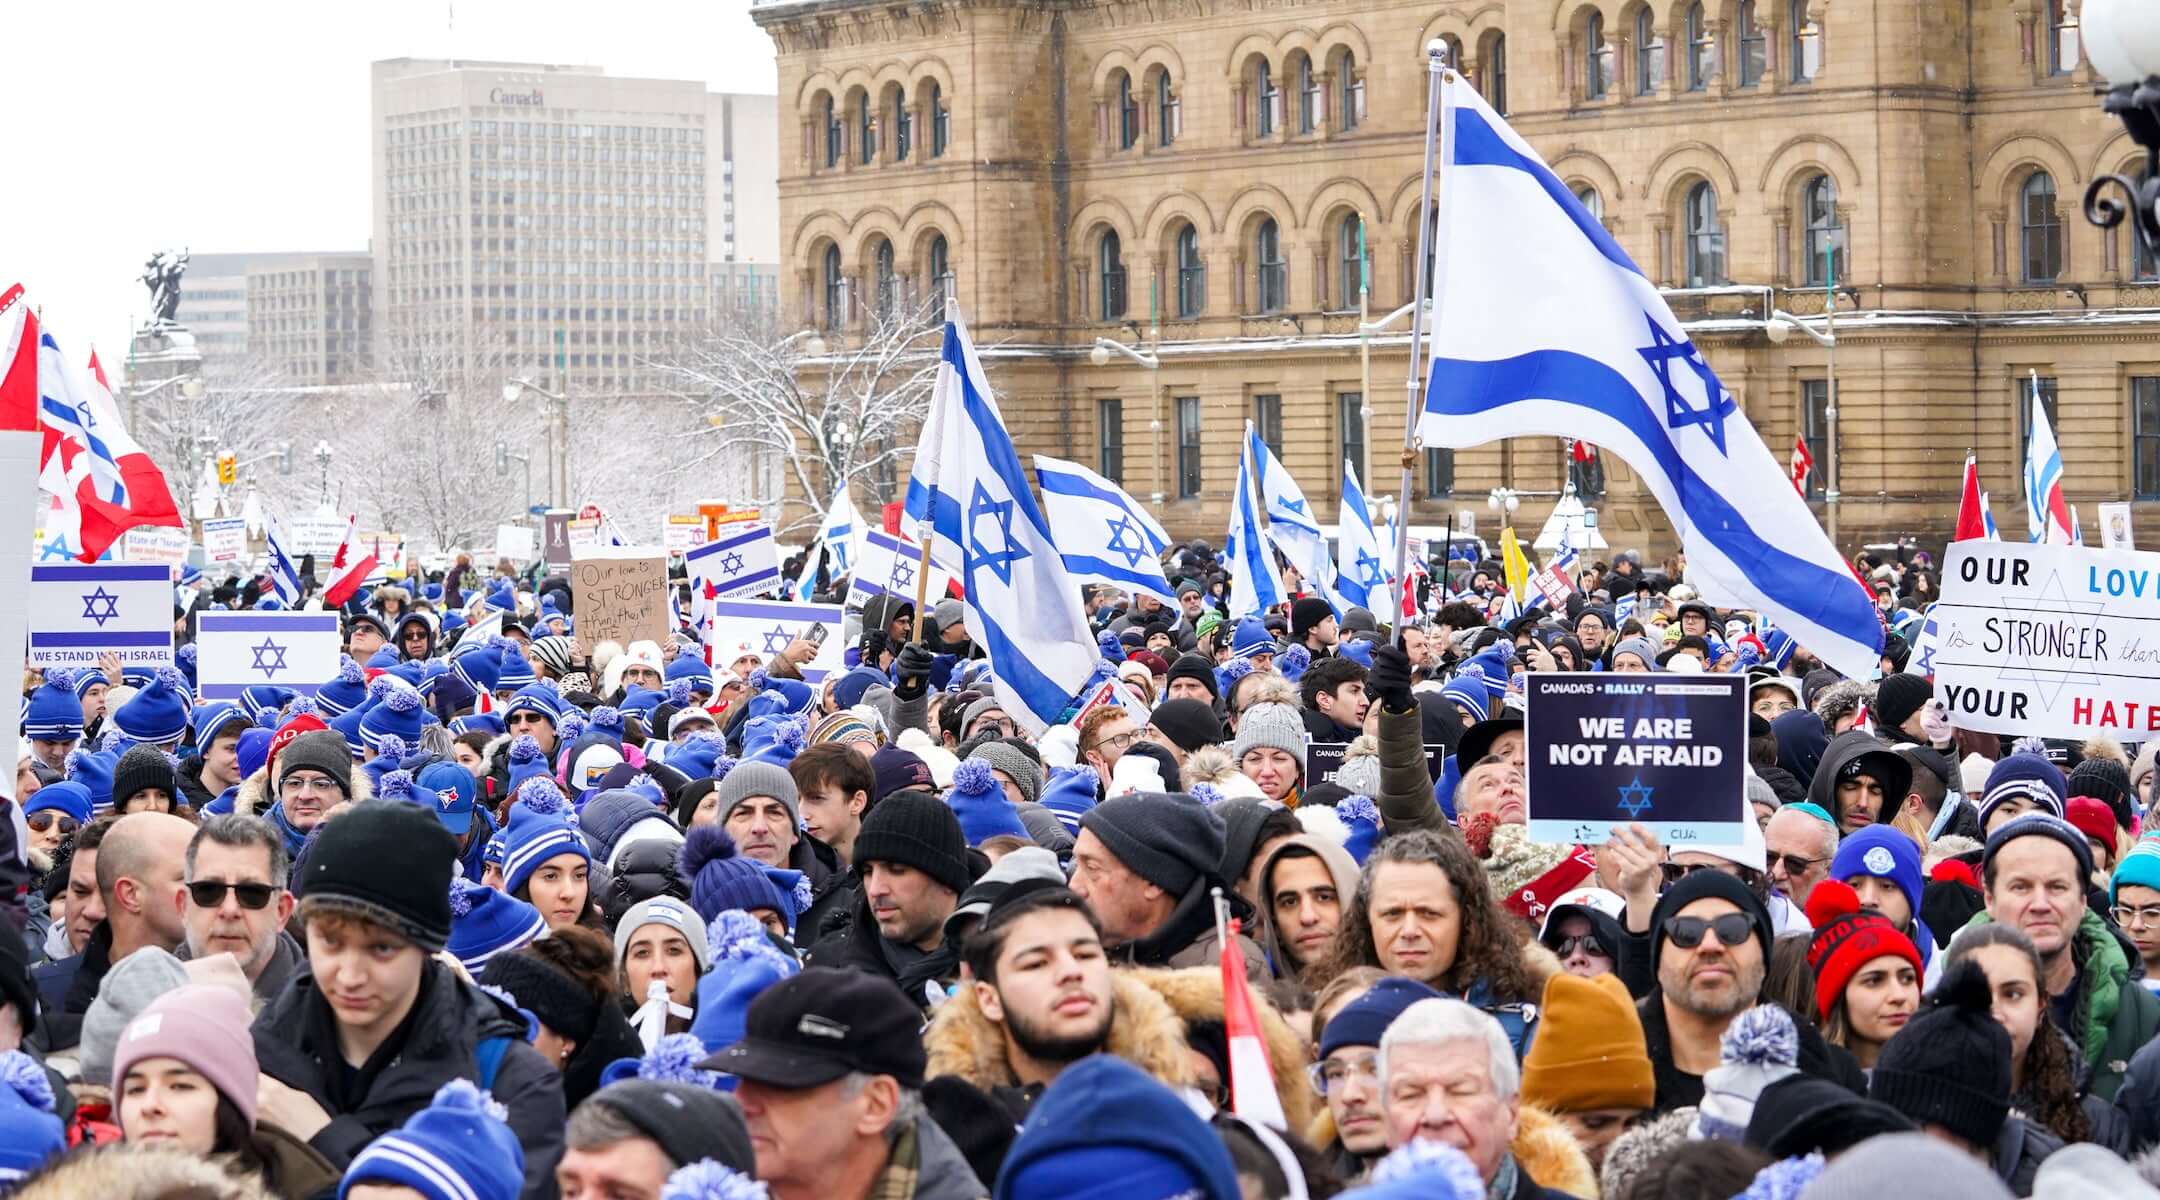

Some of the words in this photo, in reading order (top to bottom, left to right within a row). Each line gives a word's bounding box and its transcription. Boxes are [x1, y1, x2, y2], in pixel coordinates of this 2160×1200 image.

[489, 86, 544, 105] Canada
[581, 564, 613, 586] Our
[639, 561, 649, 573] is
[1961, 556, 2030, 586] OUR
[2089, 565, 2160, 600] LOV
[587, 576, 666, 612] STRONGER
[735, 585, 755, 598] WITH
[756, 577, 780, 591] ISRAEL
[852, 590, 864, 602] WE
[583, 626, 622, 643] HATE
[1945, 621, 1974, 649] is
[1983, 616, 2108, 662] STRONGER
[2118, 637, 2160, 664] than
[34, 651, 51, 661] WE
[54, 650, 94, 662] STAND
[97, 650, 127, 661] WH
[130, 650, 171, 661] ISRAEL
[1540, 683, 1595, 695] CANADA'S
[1604, 683, 1646, 695] RALLY
[1944, 684, 2029, 720] YOUR
[2072, 697, 2160, 731] HATE
[1579, 717, 1625, 739] WE
[1632, 717, 1693, 740] ARE
[1549, 743, 1607, 766] NOT
[1613, 744, 1723, 767] AFRAID
